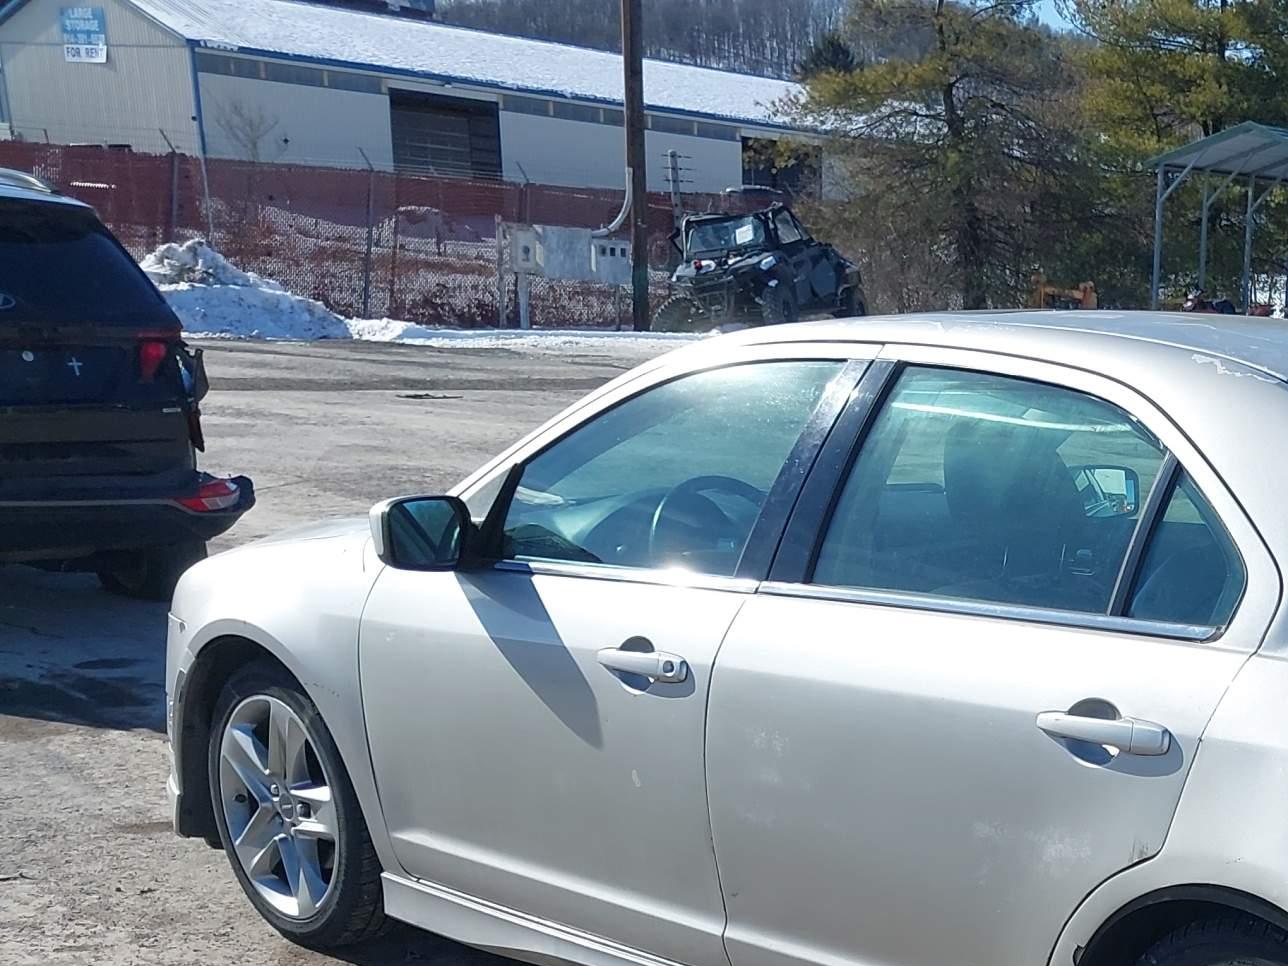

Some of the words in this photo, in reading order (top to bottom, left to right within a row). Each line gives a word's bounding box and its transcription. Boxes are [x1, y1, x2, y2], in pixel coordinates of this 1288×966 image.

[65, 19, 99, 31] STORAGE
[66, 46, 81, 58] FOR
[85, 47, 105, 58] RENT
